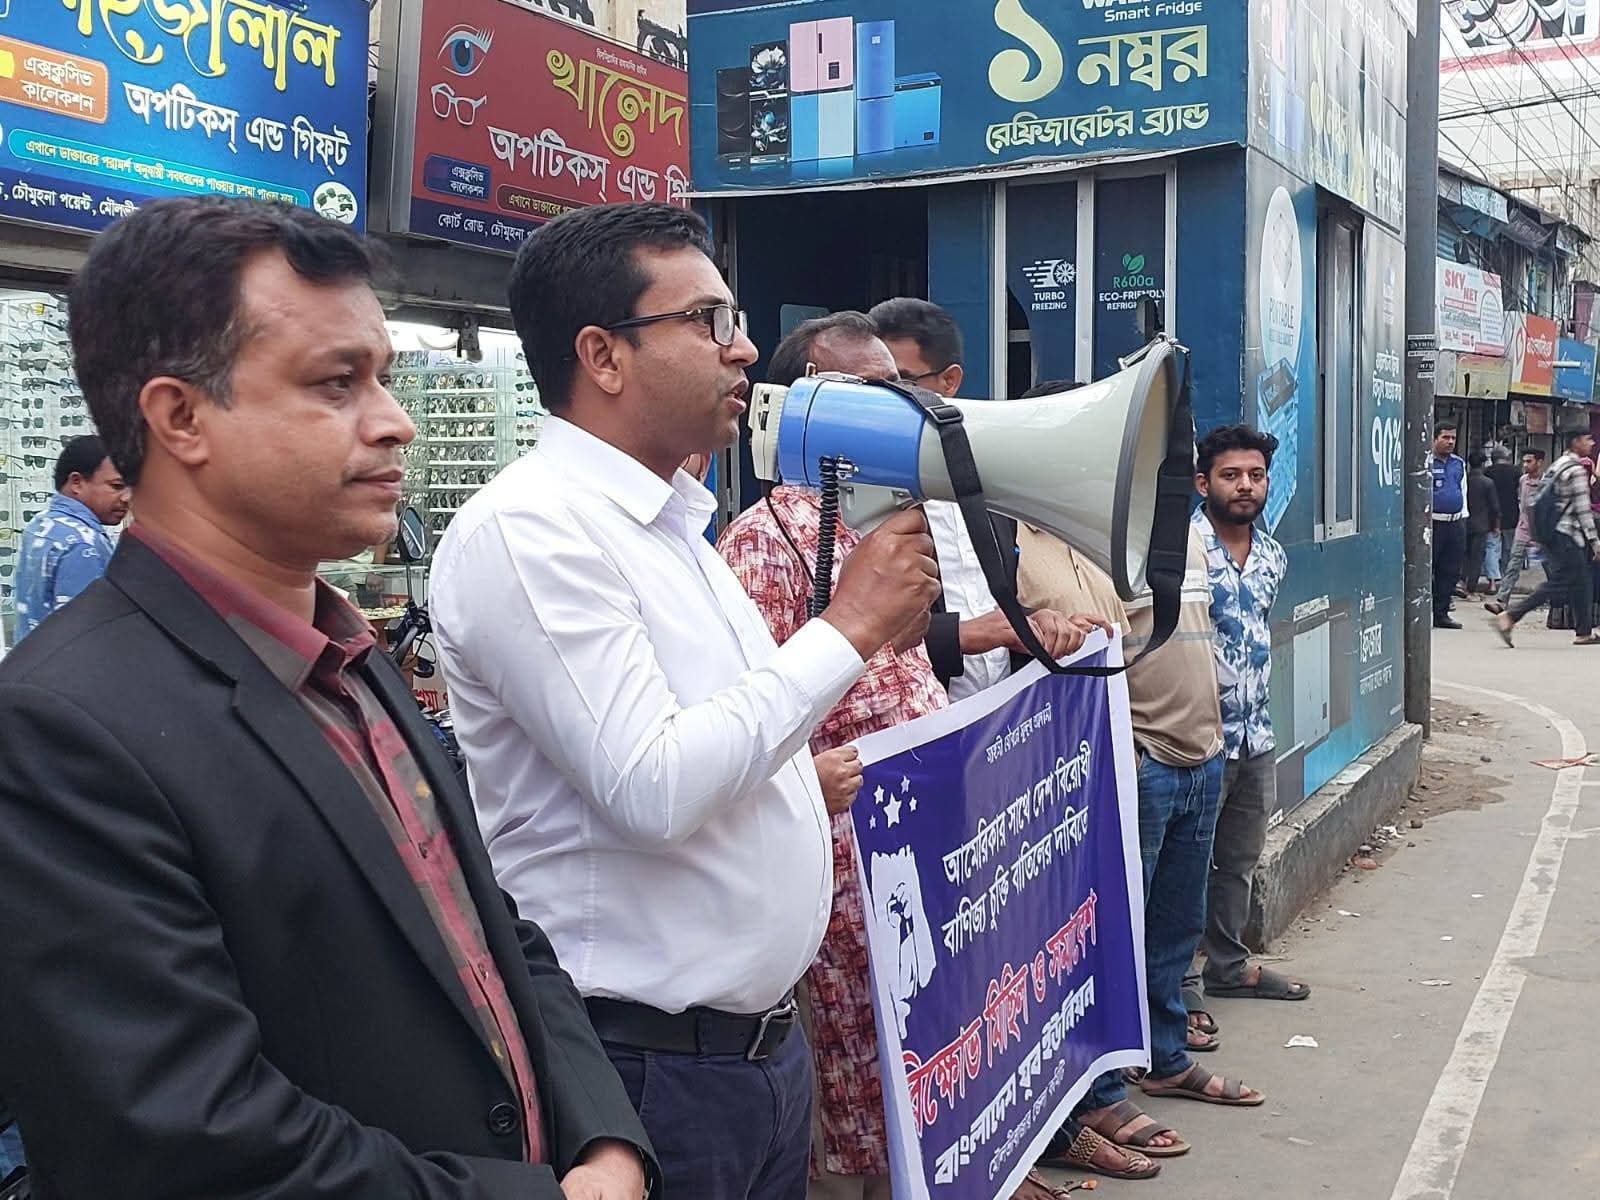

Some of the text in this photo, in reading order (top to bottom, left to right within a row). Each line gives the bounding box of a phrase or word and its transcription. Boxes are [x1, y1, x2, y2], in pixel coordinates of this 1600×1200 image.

[1104, 5, 1150, 22] Smart
[1155, 1, 1202, 15] Fridge
[988, 0, 1208, 102] ১ নম্বর
[24, 56, 96, 88] এক্সক্লুসিভ
[20, 79, 96, 113] কালেকশন
[546, 49, 687, 157] খালেদ
[122, 82, 240, 154] অপটিকস্
[245, 116, 288, 152] এন্ড
[986, 103, 1209, 155] রেফ্রিজারেটর ব্র্যান্ড
[25, 140, 56, 157] এখানে
[487, 126, 690, 208] অপটিকস্ এন্ড গি
[450, 180, 485, 197] কালেকশন
[508, 194, 531, 210] এখানে
[438, 212, 463, 230] কোর্ট
[1113, 275, 1154, 288] R600a
[1444, 268, 1466, 290] SKY
[1032, 301, 1067, 311] FREEZING
[1034, 291, 1065, 301] TURBO
[1099, 289, 1166, 302] ECO-FRIEDLY
[1464, 287, 1478, 302] NET
[941, 740, 1091, 886] আমেরিকার সাথে দেশ বিরোধী
[941, 805, 1089, 958] বাণিজ্য চুক্তি বাতিলের দাবিতে
[901, 887, 1098, 1139] বিক্ষোভ মিছিল ও সমাবেশ
[934, 975, 1096, 1185] বাংলাদেশ যুব ইউনিয়ন
